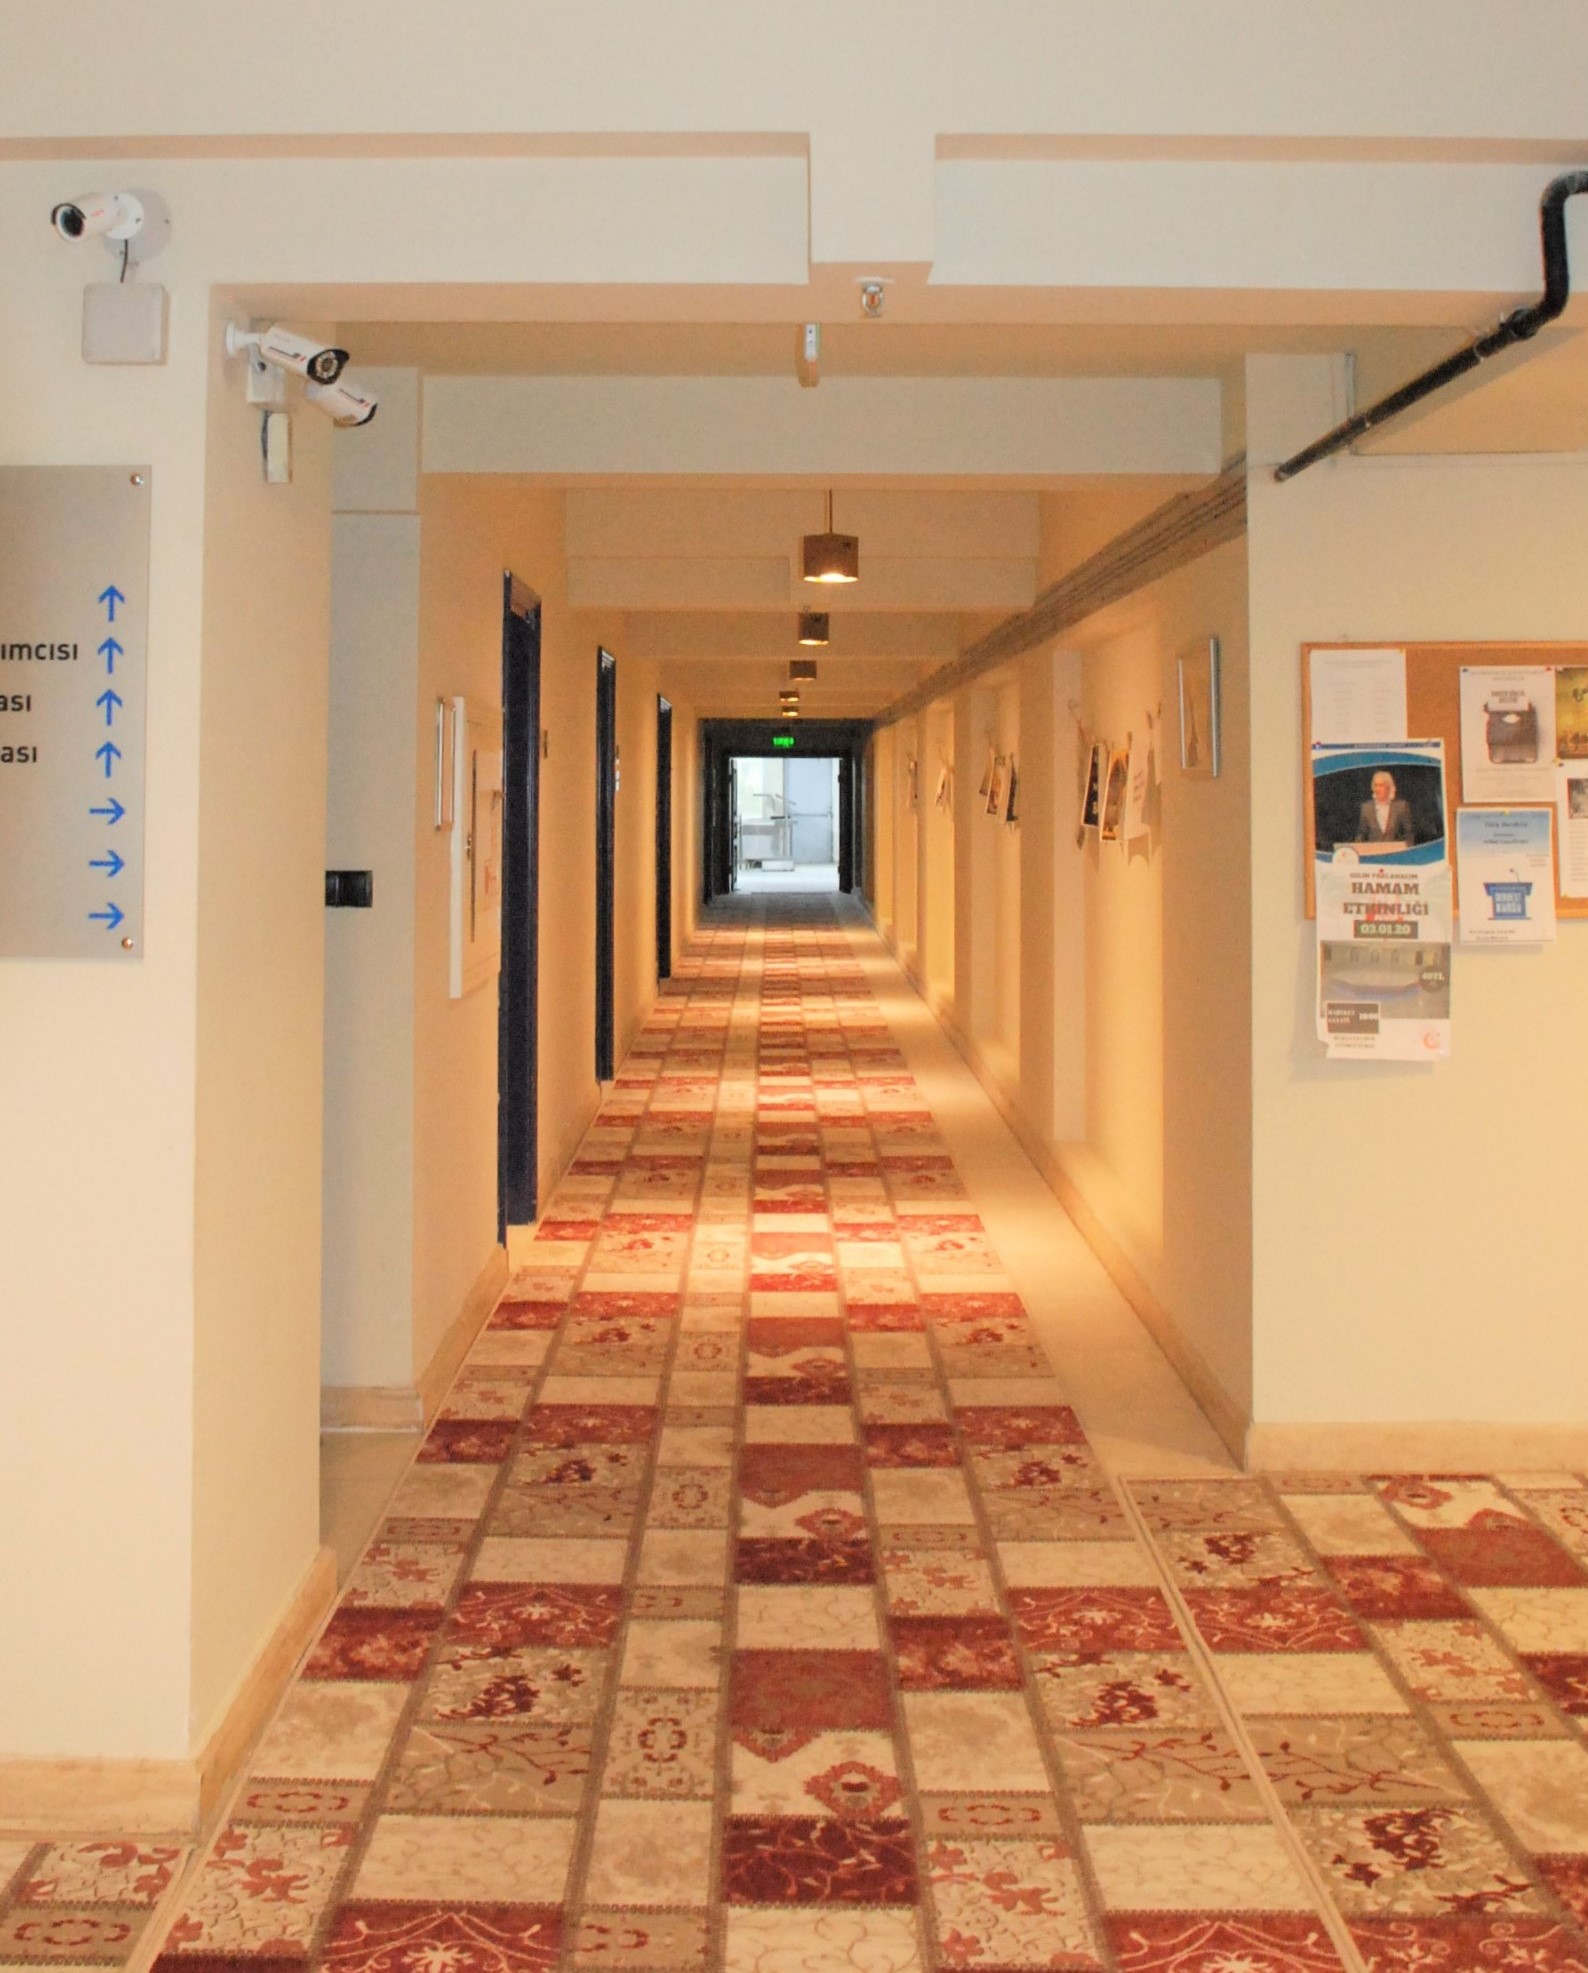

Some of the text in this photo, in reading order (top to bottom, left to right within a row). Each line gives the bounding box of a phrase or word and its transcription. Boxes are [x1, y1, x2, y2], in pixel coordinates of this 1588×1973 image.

[1, 643, 79, 661] ımcısı
[1, 746, 38, 763] ası
[1351, 881, 1420, 895] HAMAM
[1360, 923, 1411, 935] 03.01.20
